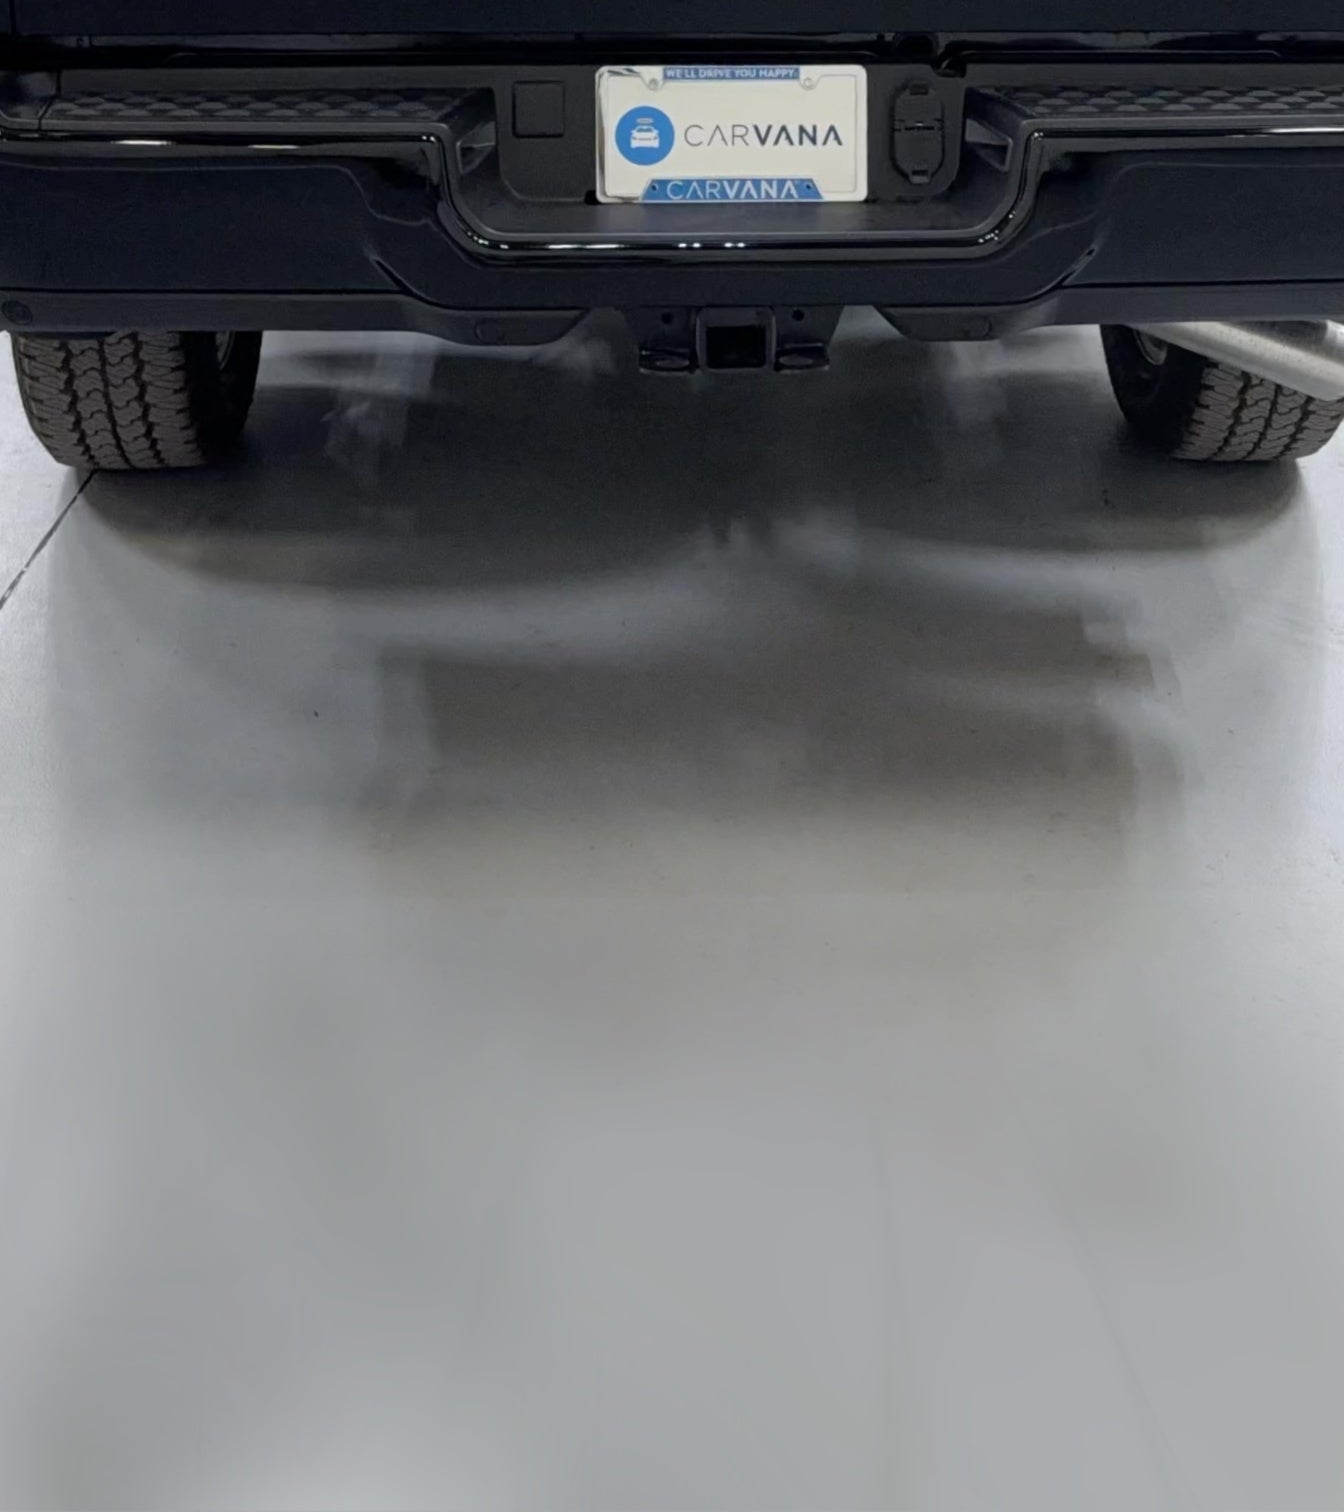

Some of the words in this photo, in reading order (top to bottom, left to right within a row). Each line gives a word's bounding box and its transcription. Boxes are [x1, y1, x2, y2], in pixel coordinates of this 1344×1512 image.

[700, 68, 732, 78] DRIVE
[734, 68, 757, 78] YOU
[759, 68, 795, 78] HAPPY
[684, 124, 843, 146] CARVANA
[667, 180, 798, 200] CARVANA
